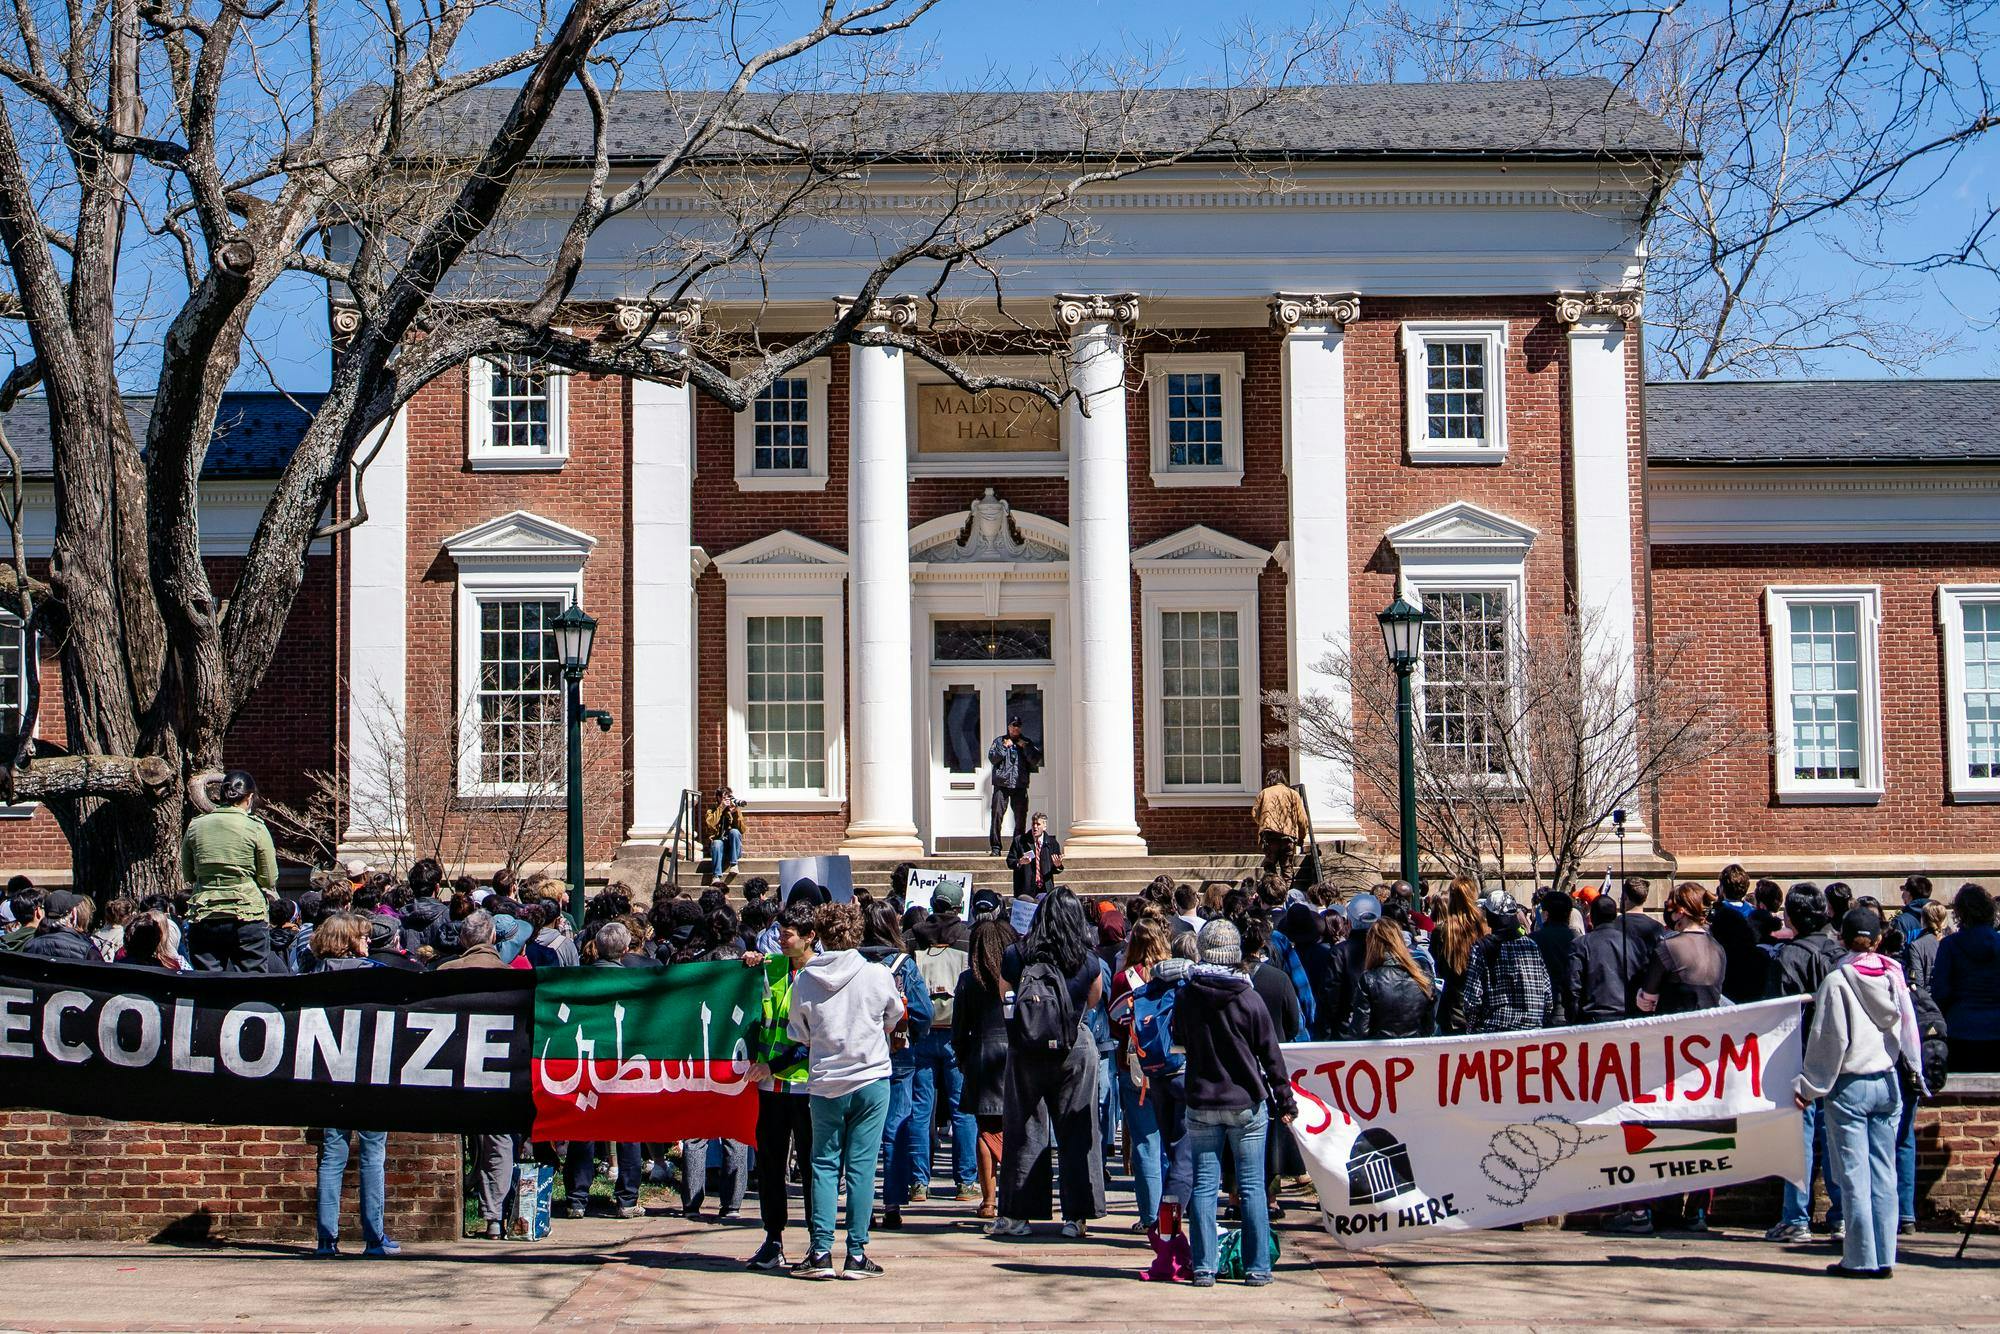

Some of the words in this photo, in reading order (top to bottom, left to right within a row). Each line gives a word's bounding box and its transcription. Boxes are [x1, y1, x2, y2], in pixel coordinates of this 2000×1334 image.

[934, 395, 1042, 415] MADISON
[958, 421, 1020, 439] HALL
[0, 986, 514, 1089] ECOLONIZE
[540, 1001, 750, 1112] فلسطين
[1290, 1056, 1414, 1135] STOP
[1438, 1033, 1762, 1107] IMPERIALISM
[1650, 1156, 1733, 1179] THERE
